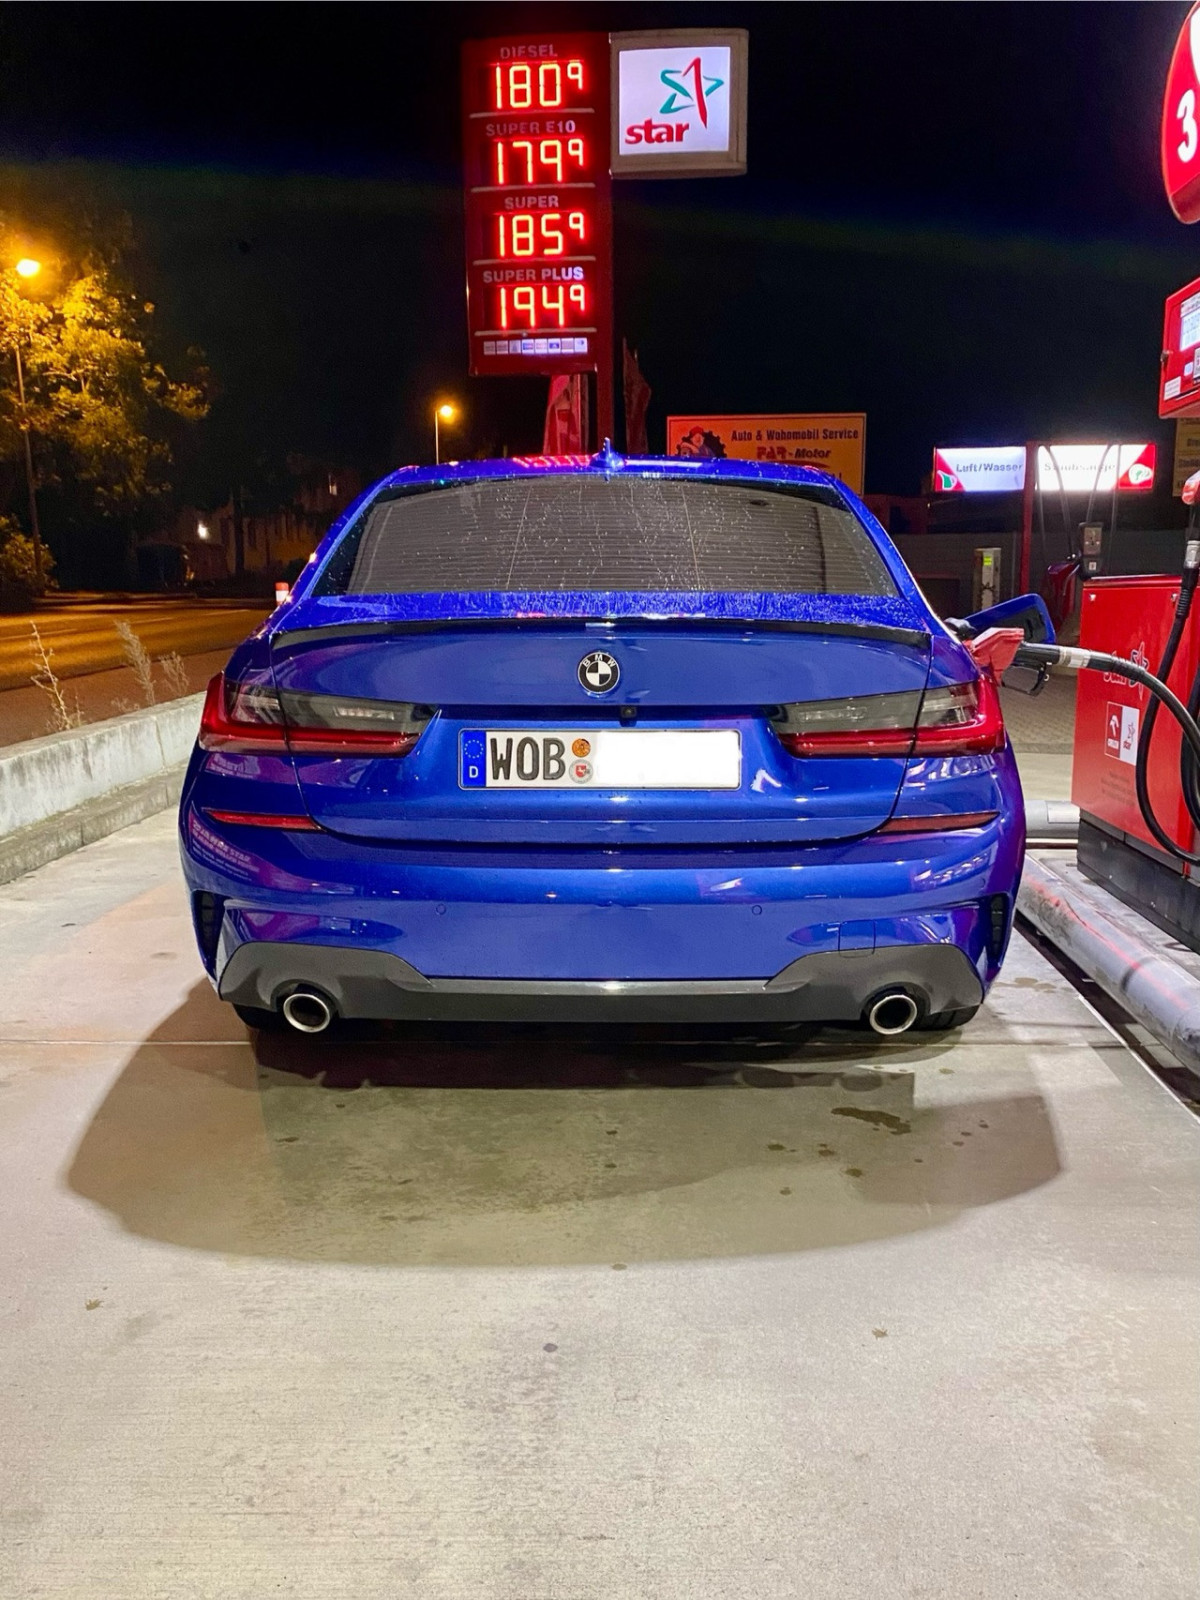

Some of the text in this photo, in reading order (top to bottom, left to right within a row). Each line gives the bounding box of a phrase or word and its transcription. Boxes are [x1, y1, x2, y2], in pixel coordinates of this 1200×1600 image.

[500, 44, 558, 59] DIESEL
[486, 120, 576, 137] SUPER E10
[625, 118, 690, 145] star
[1176, 89, 1198, 163] 3
[504, 195, 559, 209] SUPER
[483, 266, 584, 283] SUPER PLUS
[731, 430, 752, 441] Auto
[755, 430, 763, 441] &
[822, 428, 859, 440] Service
[956, 462, 1023, 473] Luft/Wasser
[581, 654, 616, 668] BMW
[490, 736, 566, 781] WOB
[469, 766, 479, 778] D
